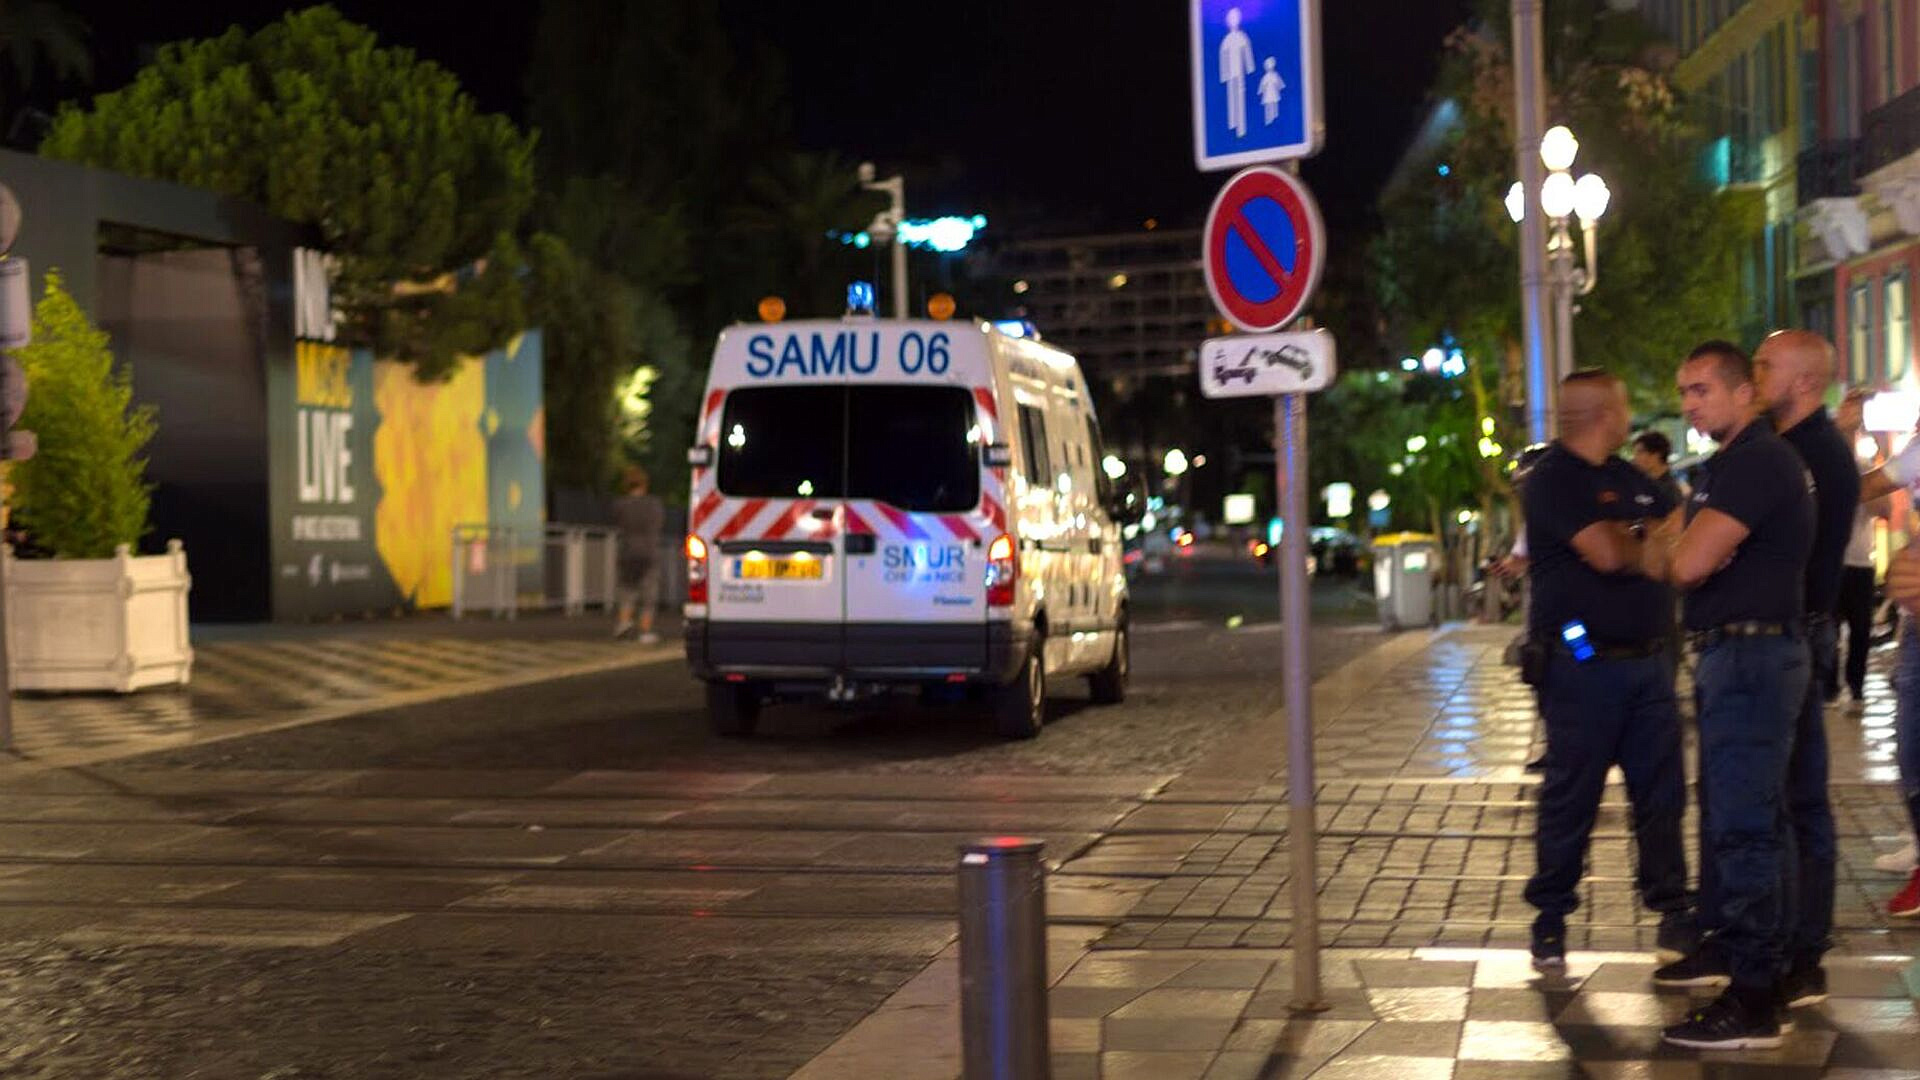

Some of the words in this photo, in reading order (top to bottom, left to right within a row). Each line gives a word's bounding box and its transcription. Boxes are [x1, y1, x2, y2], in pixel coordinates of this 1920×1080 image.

[747, 332, 879, 377] SAMU
[898, 332, 949, 375] 06
[298, 410, 354, 502] LIVE
